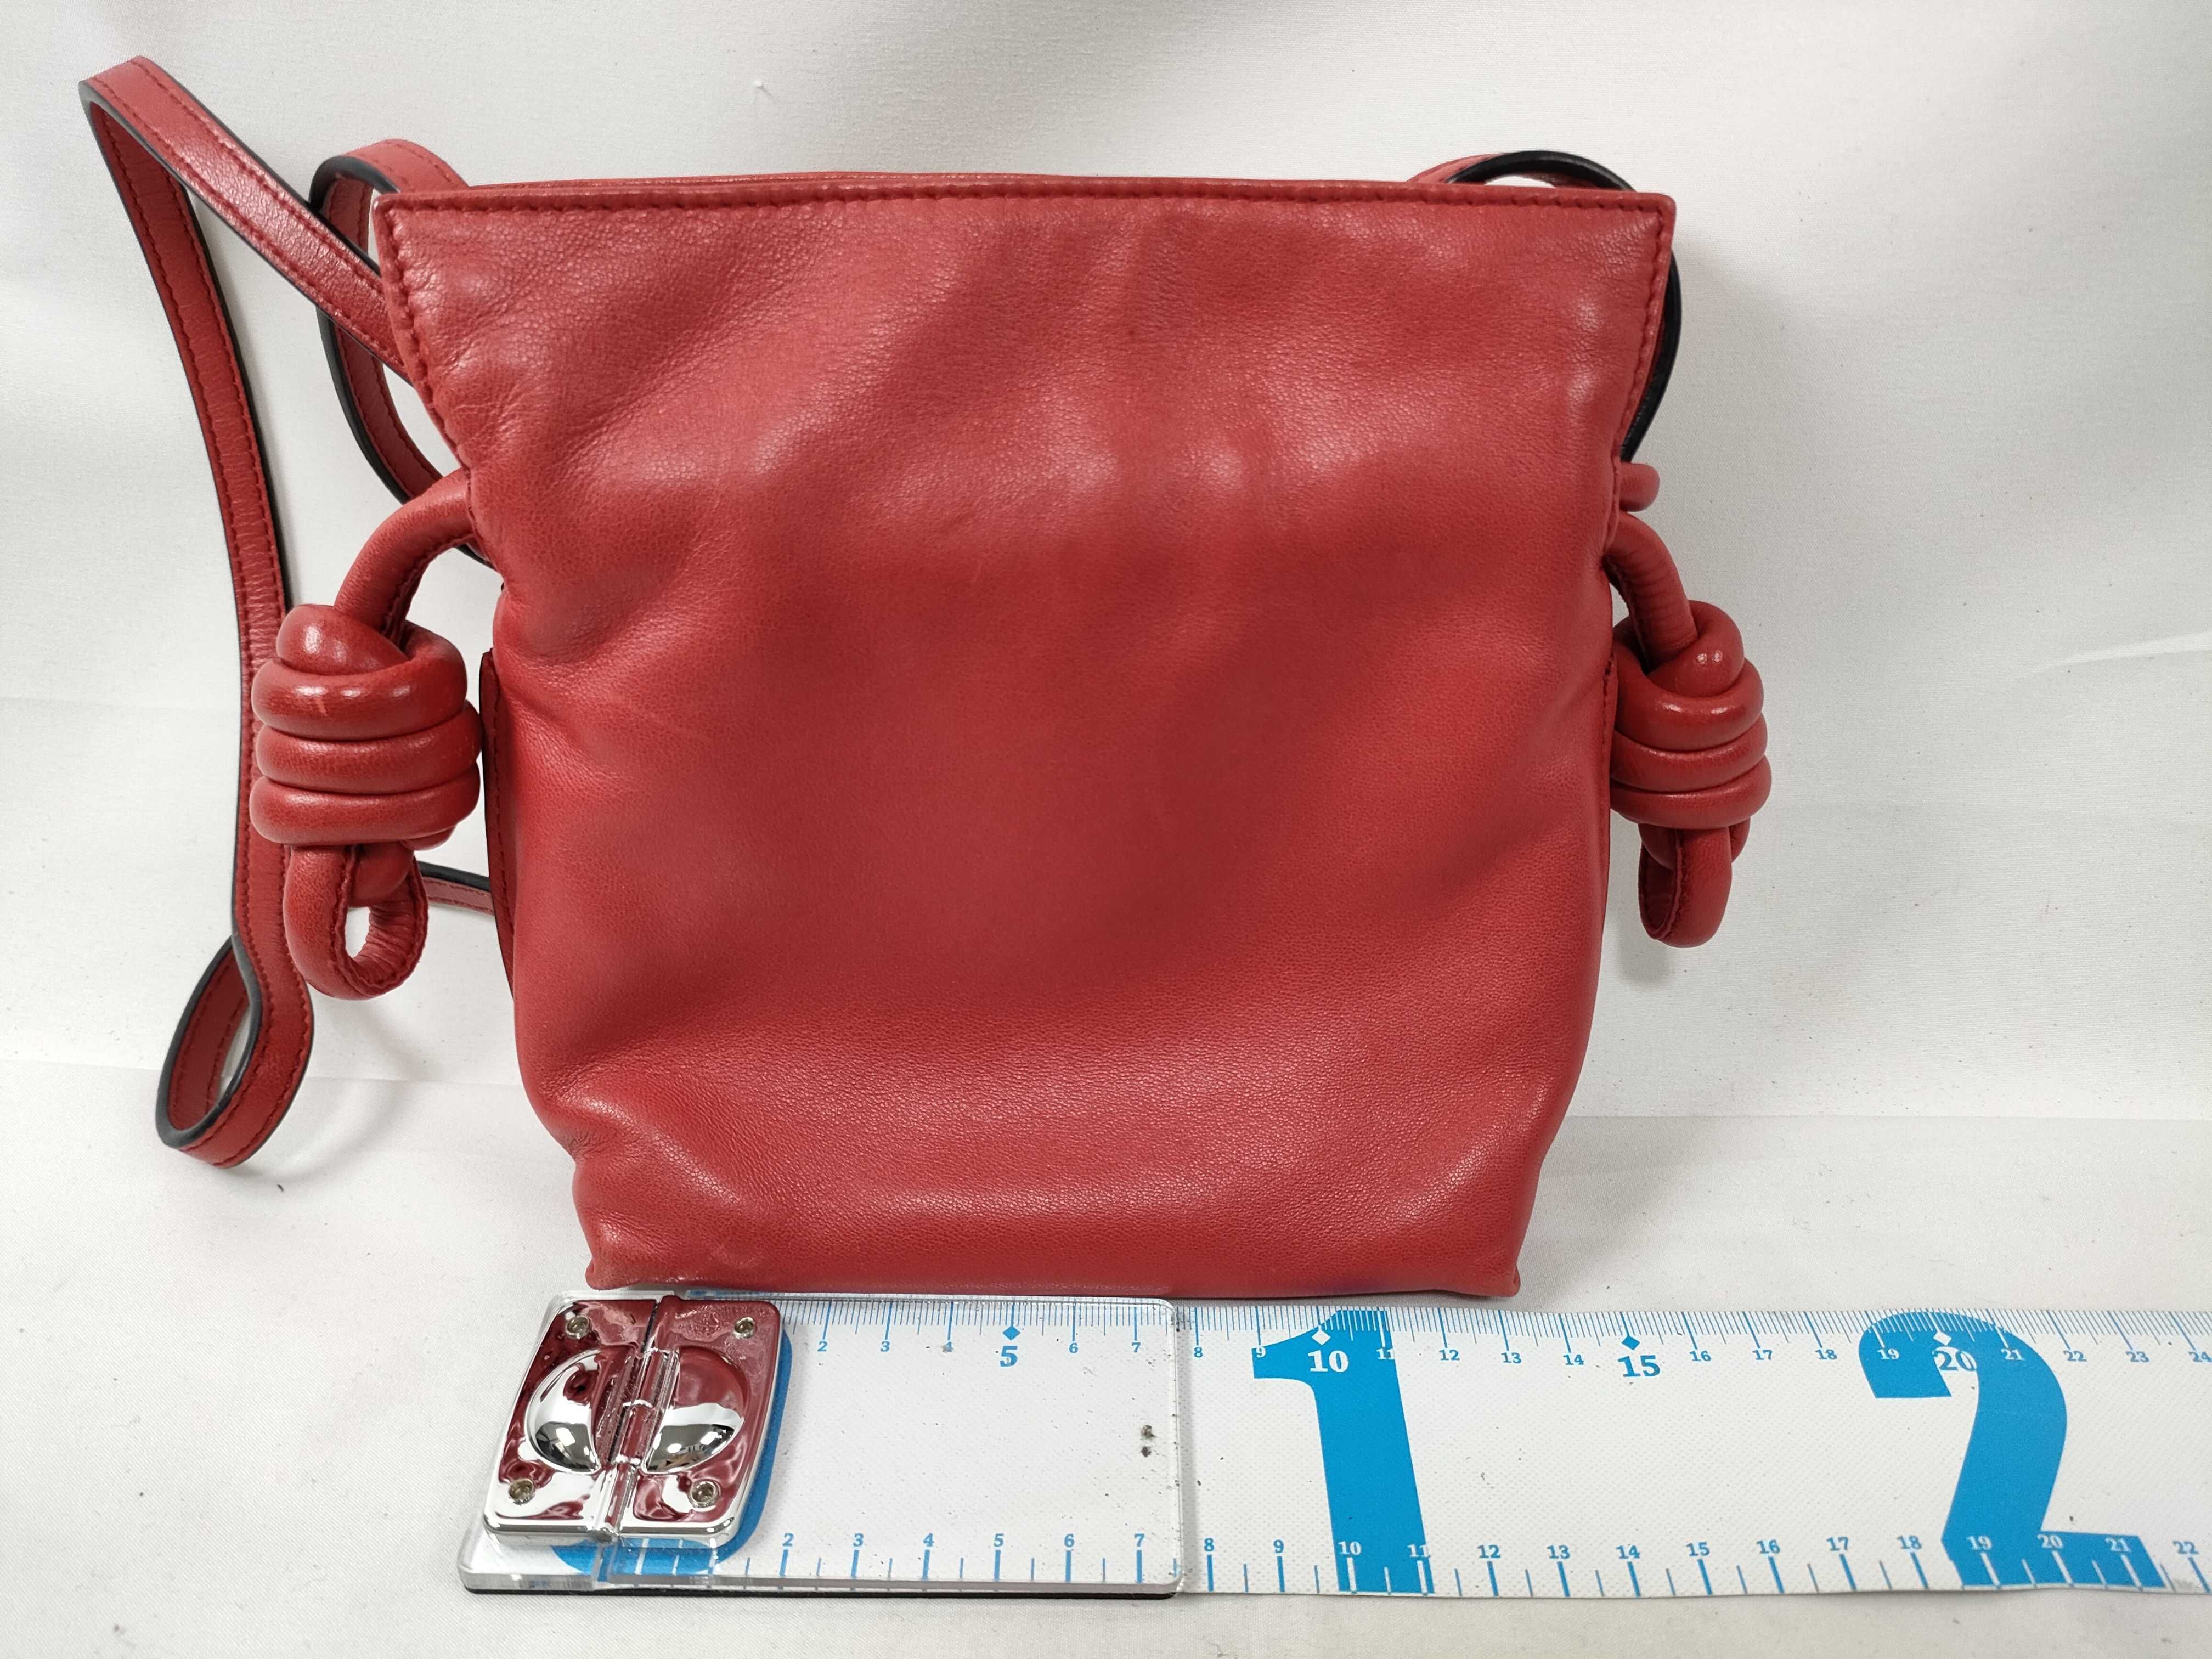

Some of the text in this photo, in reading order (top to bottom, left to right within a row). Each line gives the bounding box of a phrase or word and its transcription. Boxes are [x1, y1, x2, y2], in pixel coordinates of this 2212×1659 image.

[817, 1341, 2211, 1378] 2 3 4 5 6 7 8 9 10 11 12 13 14 15 16 17 18 19 20 21 22 23 24
[1251, 1310, 1435, 1594] 1
[1859, 1312, 2165, 1587] 2
[782, 1533, 2199, 1560] 2 3 4 5 6 7 8 9 10 11 12 13 14 15 16 17 18 19 20 21 22
